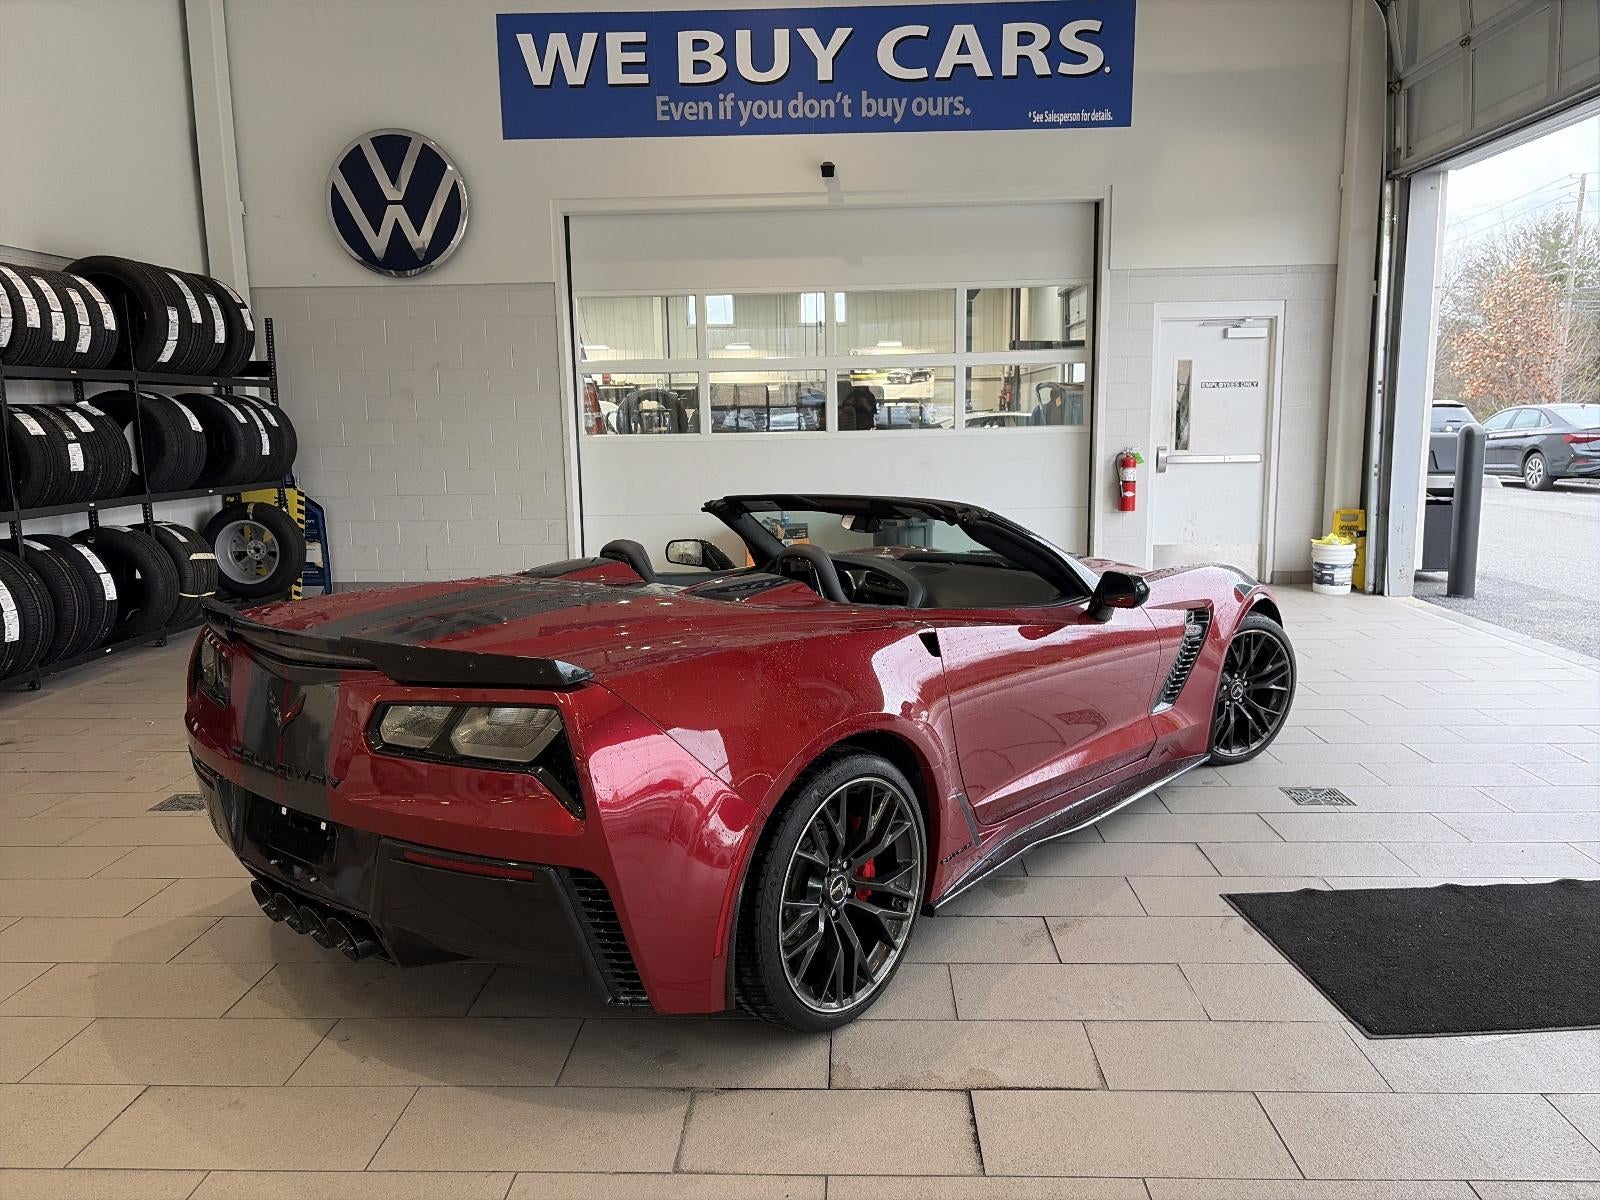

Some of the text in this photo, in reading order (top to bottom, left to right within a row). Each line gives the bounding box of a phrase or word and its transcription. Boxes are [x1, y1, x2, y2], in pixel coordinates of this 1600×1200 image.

[516, 18, 1112, 88] WE BUY CARS.
[656, 90, 971, 127] Even if you don't buy ours.
[1044, 110, 1081, 125] Salesperson
[1081, 108, 1091, 121] for
[1091, 108, 1113, 121] details.
